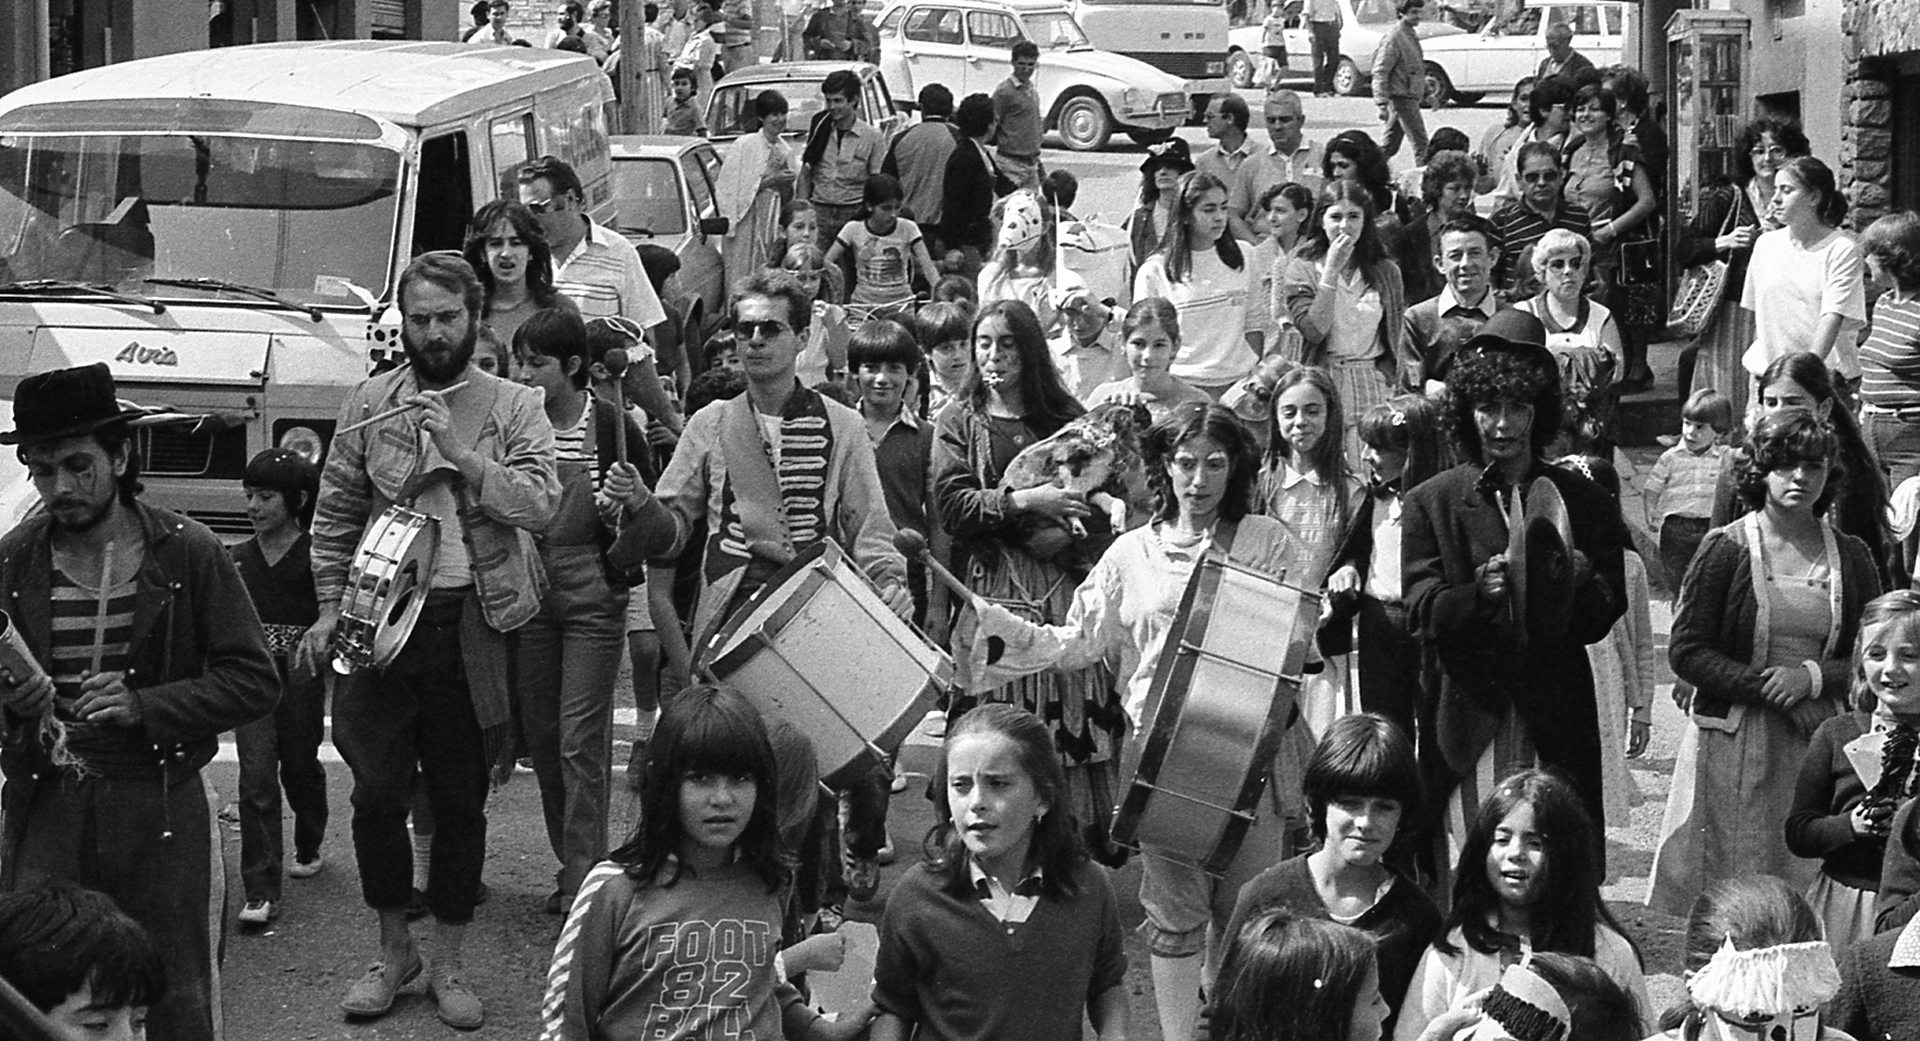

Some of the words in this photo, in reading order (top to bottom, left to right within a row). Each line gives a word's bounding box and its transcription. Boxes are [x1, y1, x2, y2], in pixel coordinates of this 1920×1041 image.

[115, 341, 178, 367] Avia
[642, 919, 770, 971] FOOT
[660, 960, 751, 1009] 82
[640, 1002, 756, 1041] BALL
